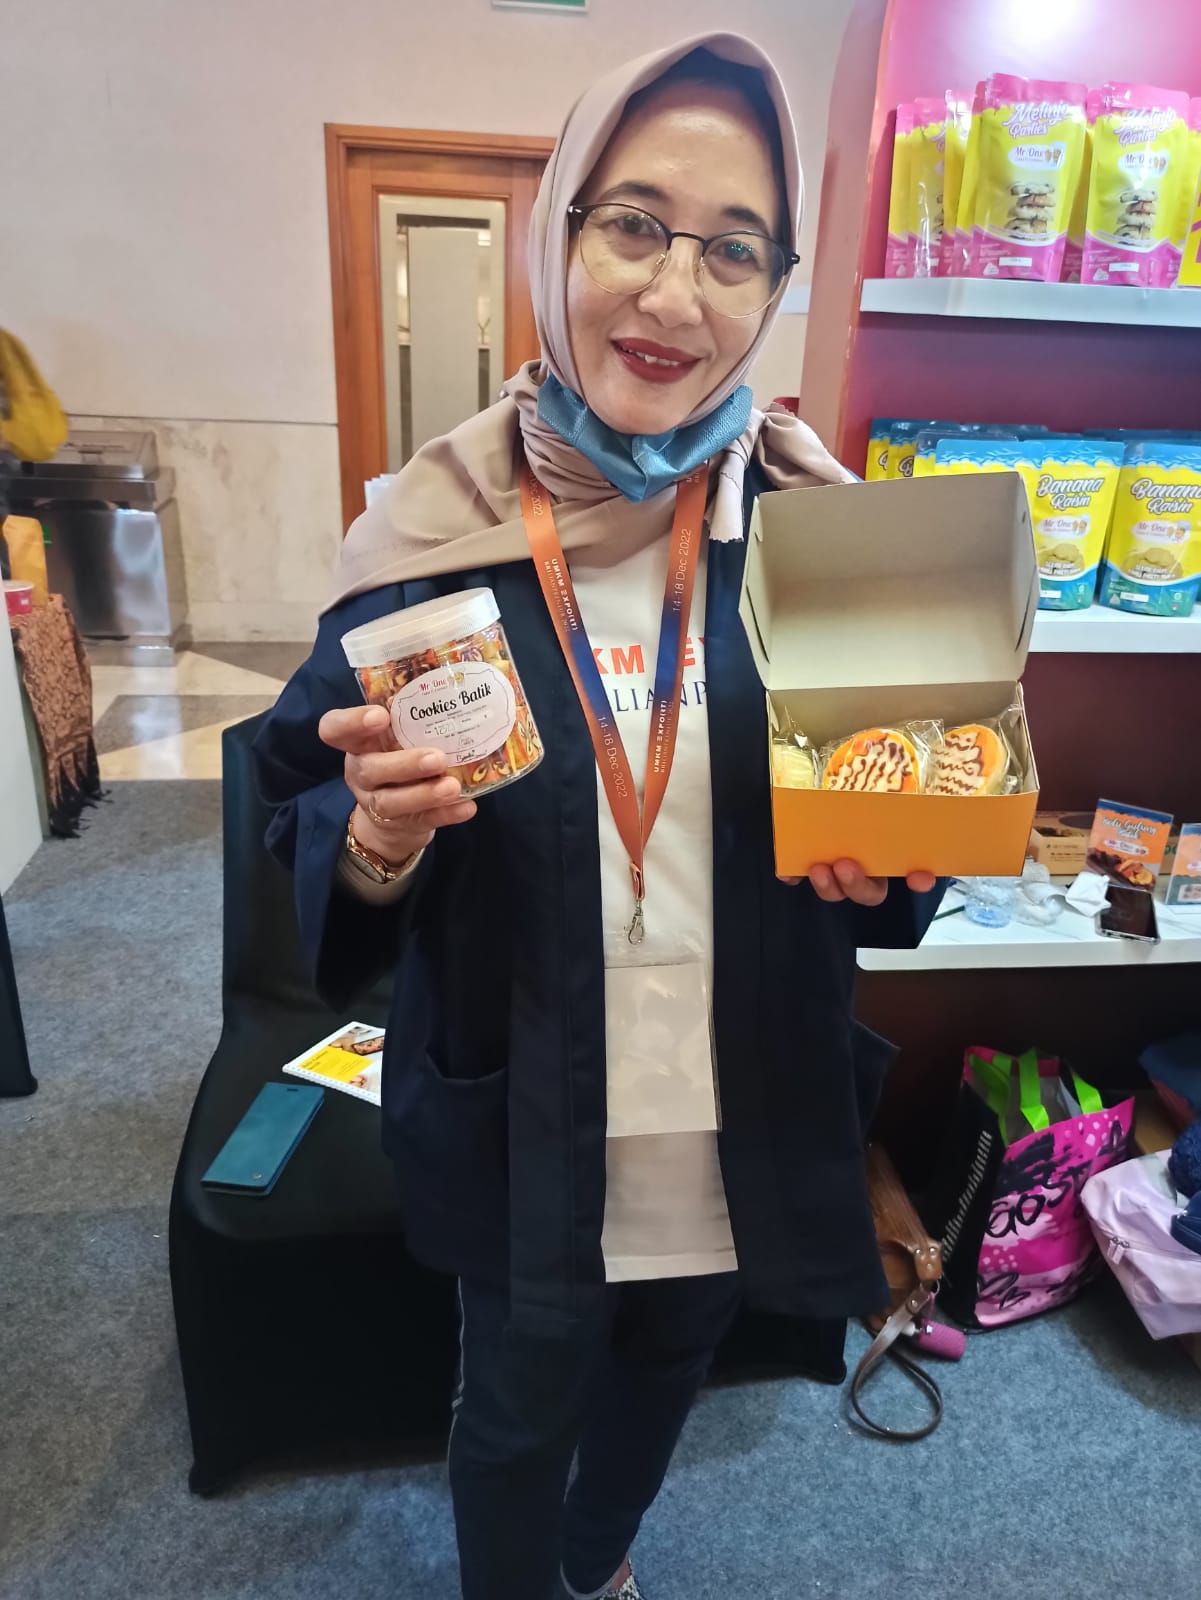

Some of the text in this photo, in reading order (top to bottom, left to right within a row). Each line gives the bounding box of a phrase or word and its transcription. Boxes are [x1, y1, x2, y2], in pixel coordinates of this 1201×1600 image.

[1036, 473, 1105, 497] Banana
[1050, 493, 1091, 511] Raisin
[1147, 497, 1193, 515] Raisin
[679, 528, 692, 556] 2022
[551, 558, 565, 587] UMKM
[676, 558, 687, 580] Dec
[410, 682, 492, 721] Cookies Batik
[598, 716, 628, 797] 14-18 Dec 2022
[653, 745, 662, 773] UMKM
